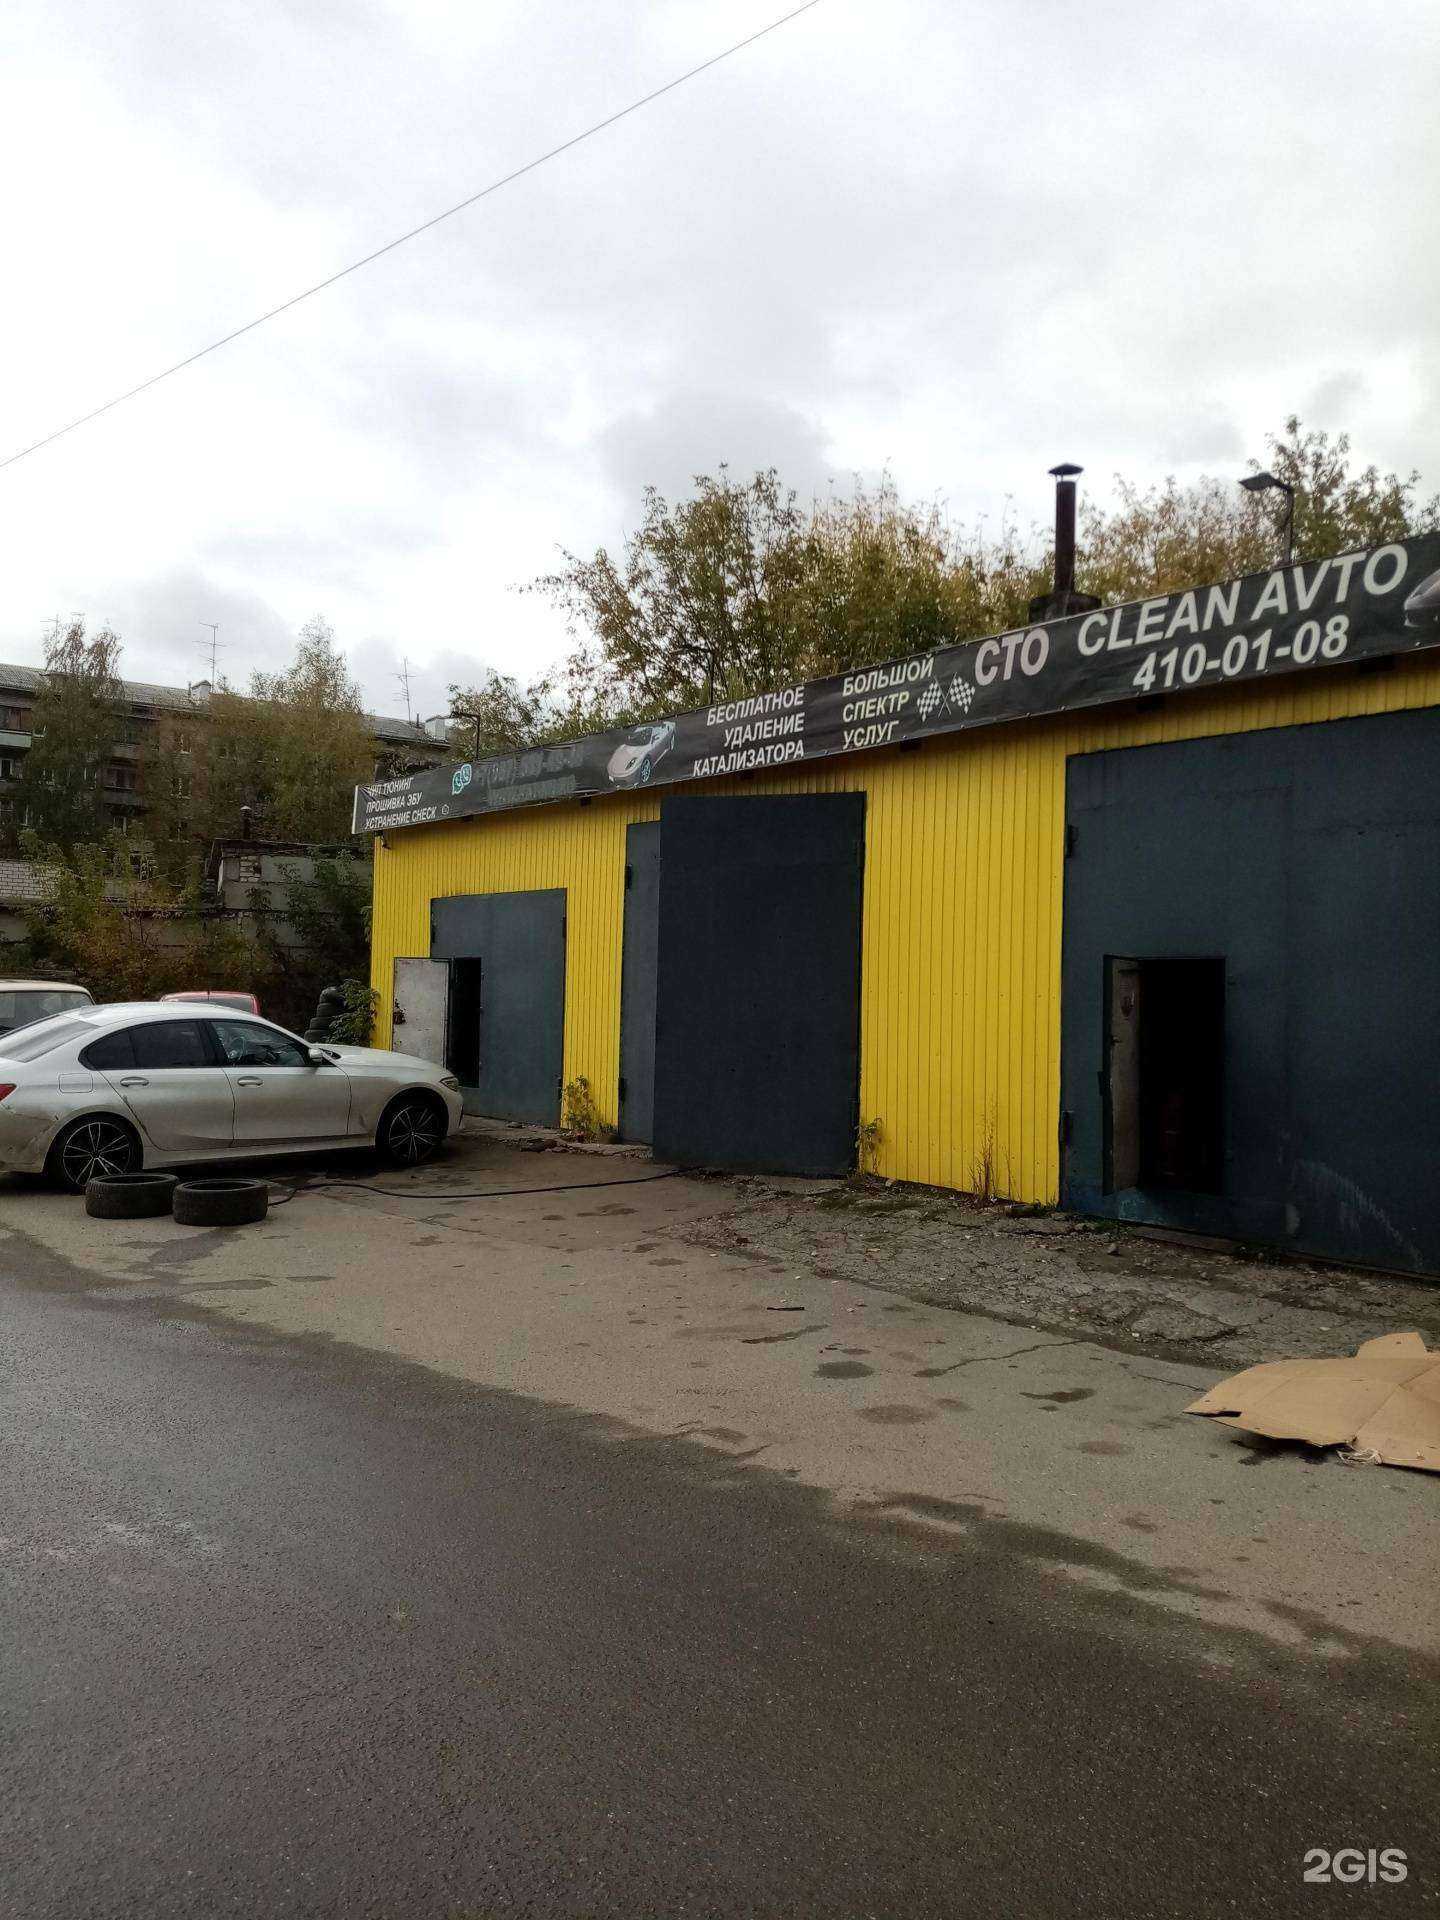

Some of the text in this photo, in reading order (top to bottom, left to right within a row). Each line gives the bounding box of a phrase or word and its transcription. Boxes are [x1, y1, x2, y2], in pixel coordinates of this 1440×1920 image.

[1078, 543, 1409, 656] CLEAN AVTO
[974, 629, 1050, 686] СТО
[1133, 614, 1350, 692] 410-01-08
[842, 655, 935, 697] БОЛЬШОЙ
[706, 685, 804, 727] БЕСПЛАТНОЕ
[842, 691, 910, 723] СПЕКТР
[723, 712, 805, 748] УДАЛЕНИЕ
[842, 720, 900, 750] УСЛУГ
[693, 740, 805, 778] КАТАЛИЗАТОРА
[365, 795, 406, 814] ПРОШИВКА
[382, 777, 414, 795] ТЮНИНГ
[364, 811, 412, 830] УСТРАНЕНИЕ
